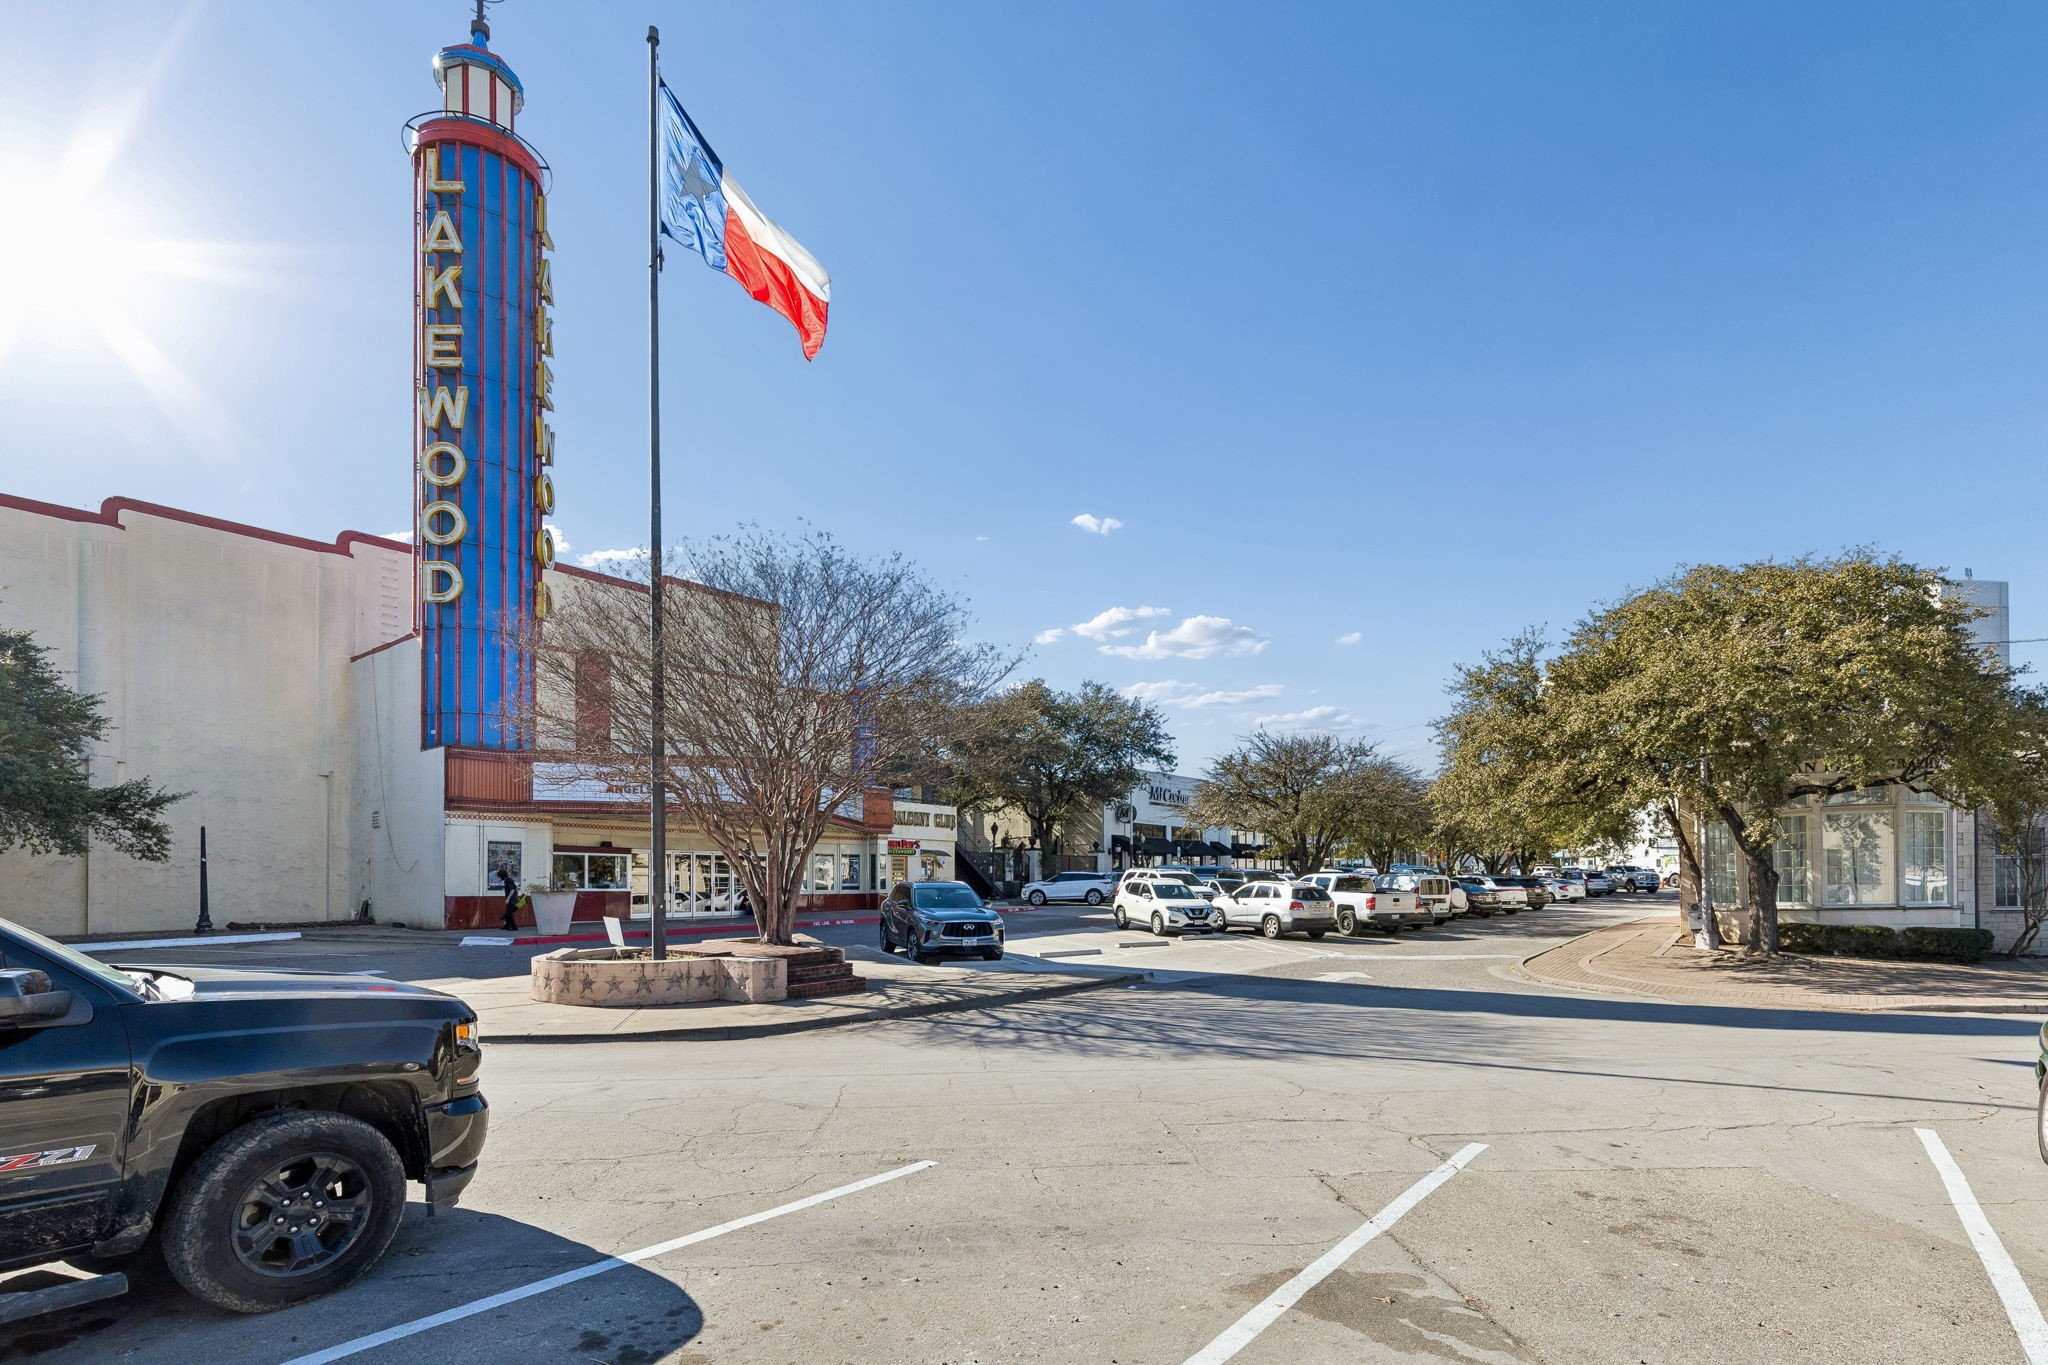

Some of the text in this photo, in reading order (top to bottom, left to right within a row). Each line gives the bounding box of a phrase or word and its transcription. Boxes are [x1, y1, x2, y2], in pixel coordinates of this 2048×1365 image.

[419, 147, 469, 603] LAKEWOOD
[893, 810, 956, 831] BALCONY CLUB
[0, 1144, 96, 1171] Z71
